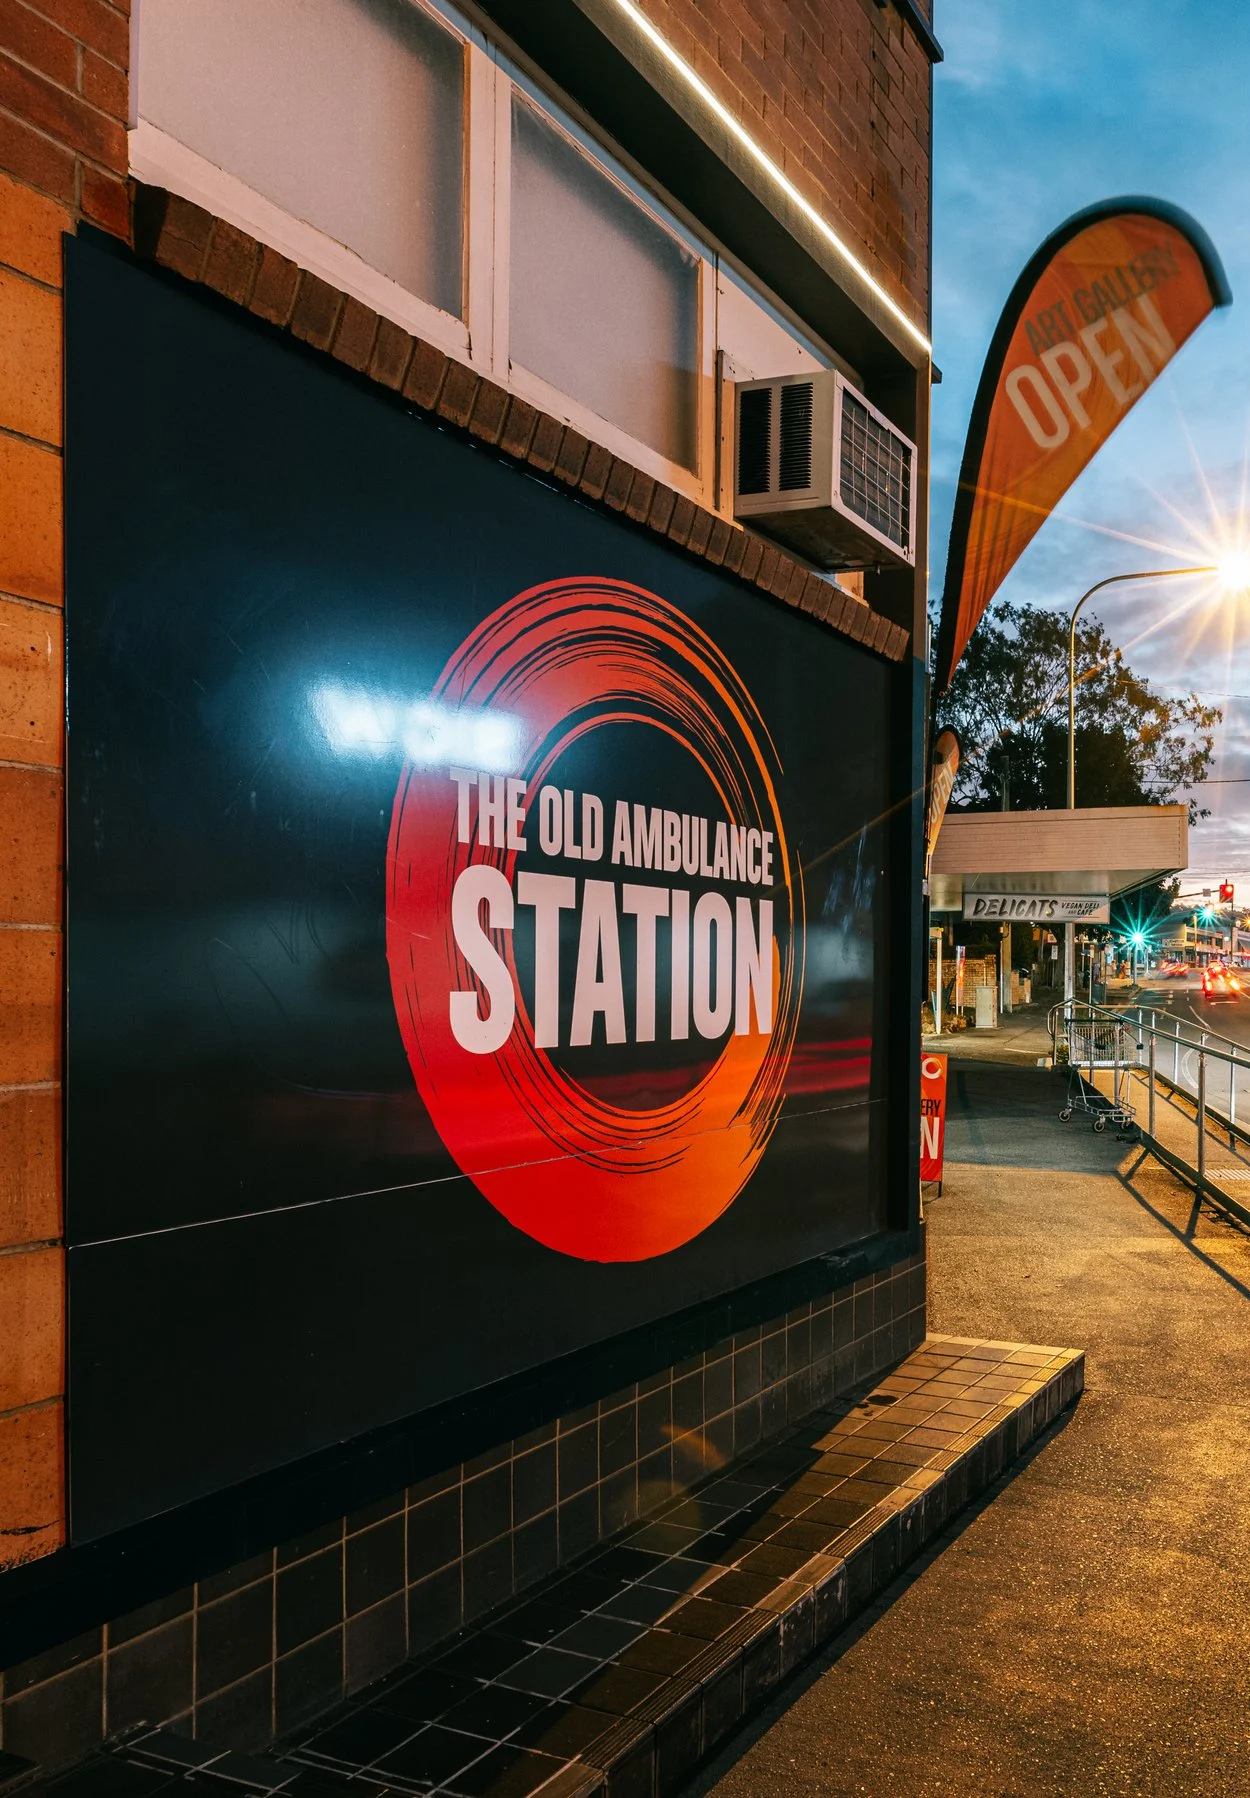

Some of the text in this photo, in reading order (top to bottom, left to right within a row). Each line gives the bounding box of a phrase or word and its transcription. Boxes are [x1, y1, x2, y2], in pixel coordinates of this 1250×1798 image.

[1023, 239, 1181, 358] ART GALLERY
[1005, 294, 1177, 449] OPEN
[449, 767, 774, 886] THE OLD AMBULANCE
[449, 864, 774, 1055] STATION
[973, 898, 1059, 918] DELICATS
